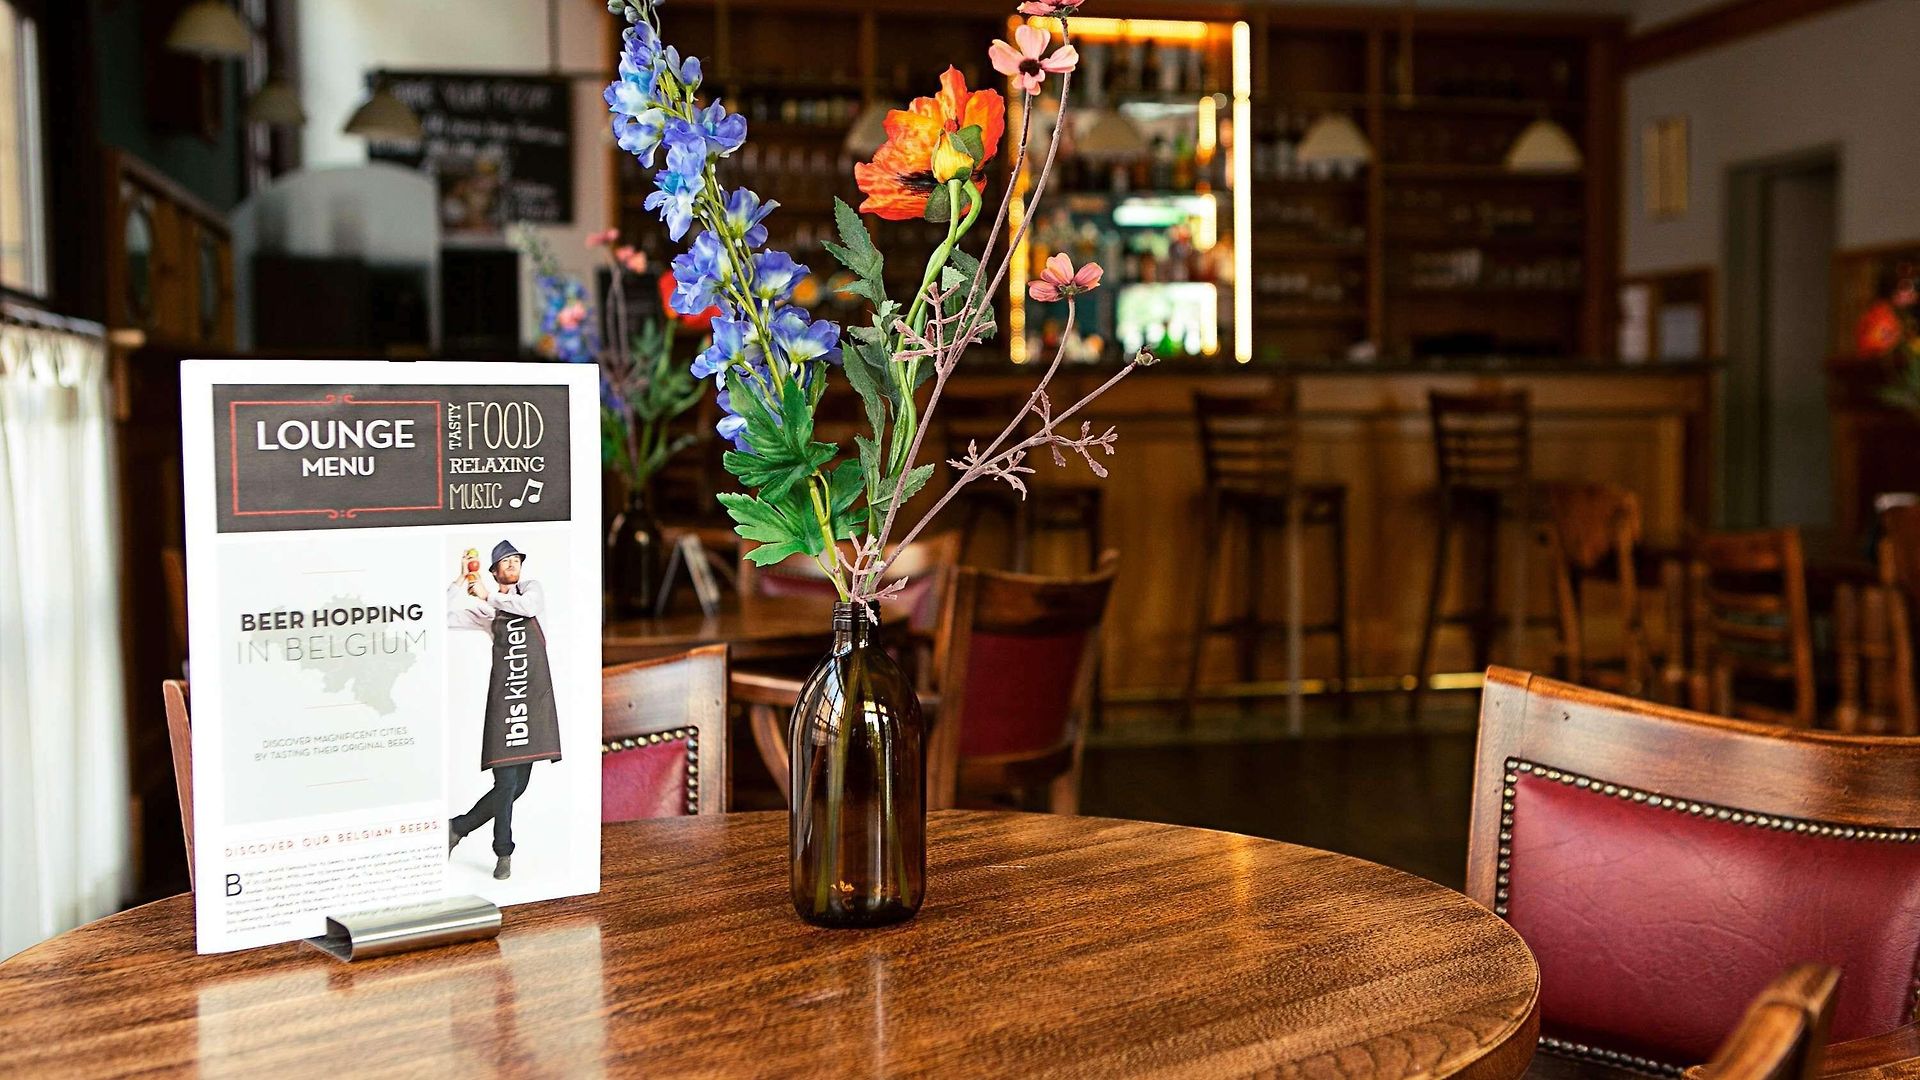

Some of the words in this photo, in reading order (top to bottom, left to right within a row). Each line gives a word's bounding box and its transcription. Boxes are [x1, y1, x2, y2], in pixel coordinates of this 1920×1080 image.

[257, 419, 416, 451] LOUNGE
[448, 402, 461, 450] TASTY
[468, 401, 545, 450] FOOD
[302, 456, 375, 477] MENU
[449, 456, 545, 474] RELAXING
[450, 482, 503, 510] MUSIC
[241, 610, 304, 632] BEER
[312, 603, 424, 628] HOPPING
[237, 639, 269, 665] IN
[286, 629, 427, 661] BELGIUM
[503, 617, 528, 700] kitchen
[262, 735, 312, 749] DISCOVER
[314, 729, 377, 743] MAGNIFICENT
[379, 726, 409, 737] CITIES
[504, 702, 529, 747] ibis
[254, 752, 267, 762] BY
[271, 748, 311, 760] TASTING
[341, 740, 385, 753] ORIGINAL
[387, 737, 415, 748] BEERS
[225, 840, 294, 857] DISCOVER
[303, 834, 330, 847] OUR
[338, 826, 393, 842] BELGIAN
